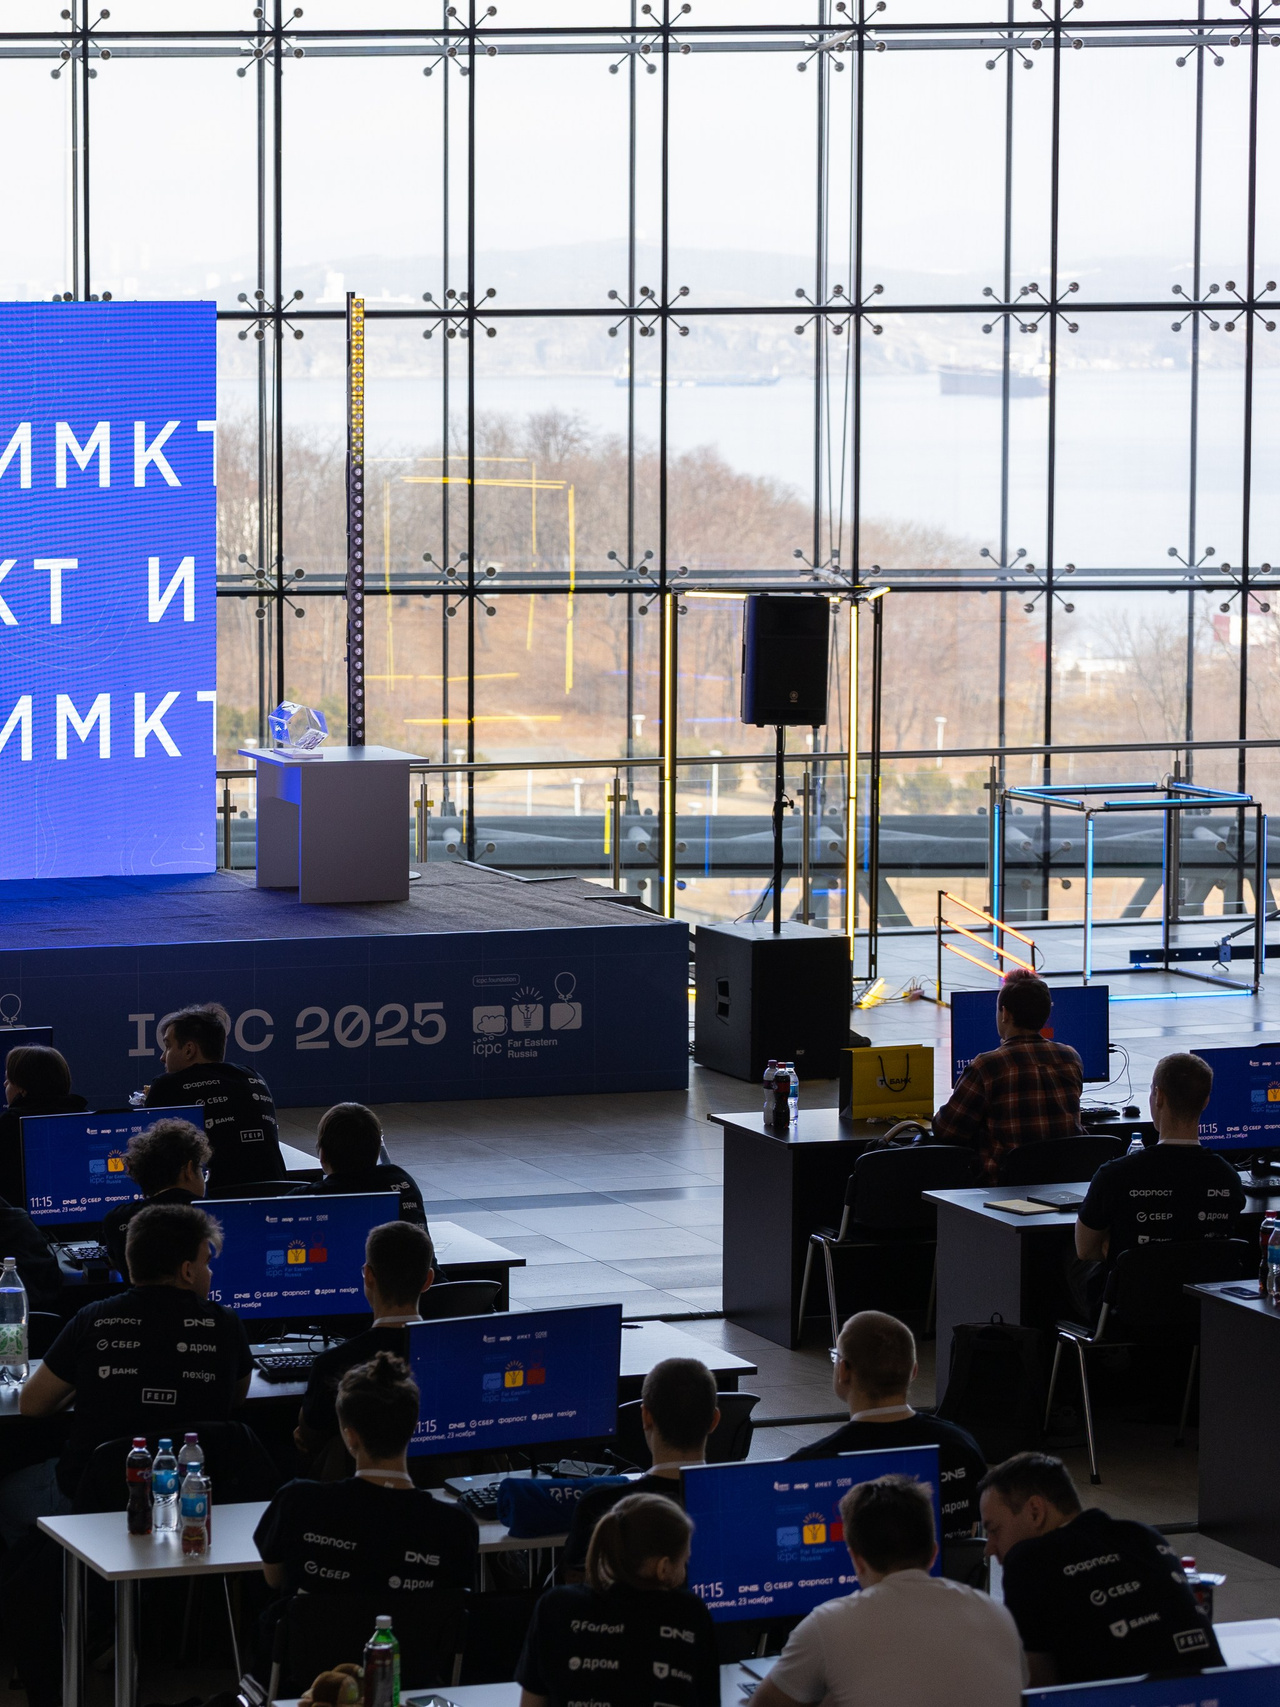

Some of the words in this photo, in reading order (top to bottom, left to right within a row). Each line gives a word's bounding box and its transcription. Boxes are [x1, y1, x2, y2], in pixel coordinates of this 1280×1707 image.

[148, 556, 195, 623] И
[128, 1008, 275, 1058] IC
[295, 1001, 447, 1051] 2025
[507, 1039, 522, 1048] Far
[524, 1038, 558, 1047] Eastern
[472, 1041, 502, 1058] icpc
[507, 1049, 538, 1058] Russia
[890, 1077, 911, 1085] БАНК
[207, 1096, 228, 1105] СБЕР
[215, 1116, 235, 1124] БАНК
[1198, 1123, 1218, 1134] 11:15
[390, 1181, 410, 1192] DNS
[1207, 1189, 1230, 1197] DNS
[30, 1196, 52, 1208] 11:15
[1149, 1213, 1173, 1221] СБЕР
[339, 1286, 358, 1294] nexign
[241, 1301, 261, 1309] ноября
[183, 1318, 216, 1327] DNS
[111, 1340, 141, 1349] СБЕР
[189, 1343, 217, 1353] дром
[112, 1367, 138, 1375] БАНК
[182, 1370, 216, 1382] nexign
[146, 1392, 173, 1401] FEIP
[557, 1409, 577, 1418] nexign
[416, 1419, 437, 1433] 1:15
[477, 1418, 494, 1426] СБЕР
[455, 1430, 476, 1438] ноября
[404, 1550, 441, 1566] DNS
[777, 1552, 798, 1563] icpc
[319, 1567, 351, 1581] СБЕР
[403, 1577, 434, 1591] дром
[692, 1582, 724, 1599] 11:15
[738, 1584, 759, 1593] DNS
[773, 1581, 794, 1590] СБЕР
[1107, 1580, 1141, 1598] СБЕР
[738, 1598, 747, 1606] 23
[748, 1595, 774, 1605] ноября
[1129, 1612, 1161, 1629] БАНК
[581, 1620, 625, 1634] FarPost
[660, 1625, 695, 1644] DNS
[1178, 1633, 1204, 1648] FEIP
[582, 1658, 619, 1671] дром
